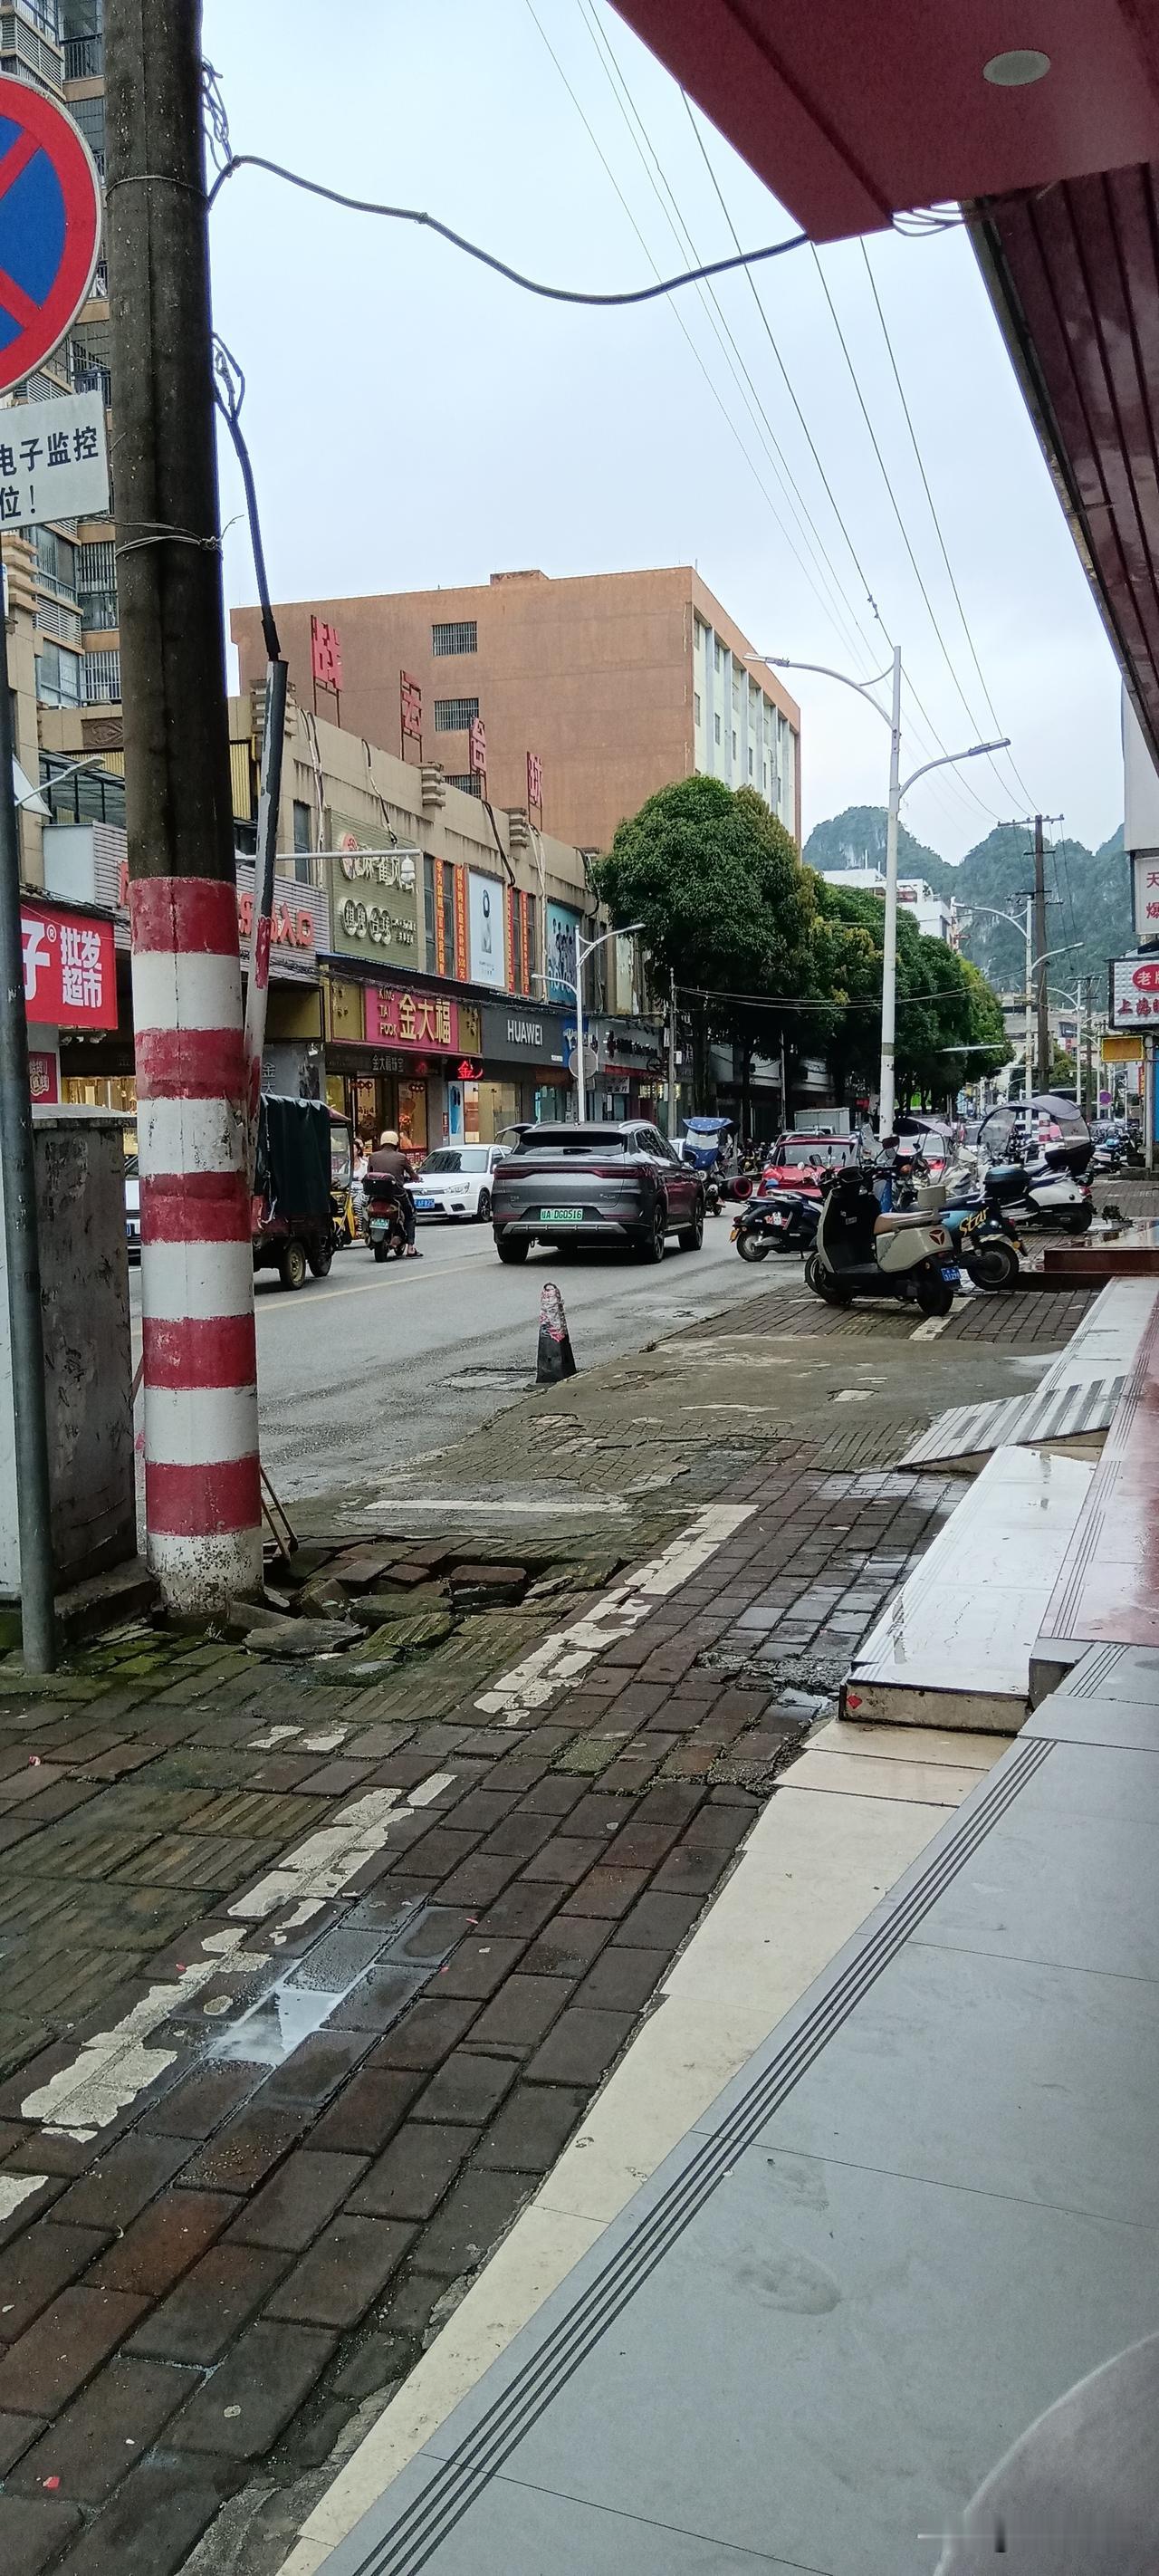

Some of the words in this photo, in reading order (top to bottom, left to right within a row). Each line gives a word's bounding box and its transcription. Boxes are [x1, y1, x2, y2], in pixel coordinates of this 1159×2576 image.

[0, 426, 99, 476] 电子监控
[1146, 871, 1159, 889] 天
[60, 925, 102, 970] 批发
[62, 966, 102, 1008] 超市
[1136, 971, 1159, 985] 老
[379, 1004, 391, 1019] TAI
[398, 994, 451, 1044] 金大福
[379, 1024, 398, 1037] FOOK
[507, 1019, 543, 1047] HUAWEI
